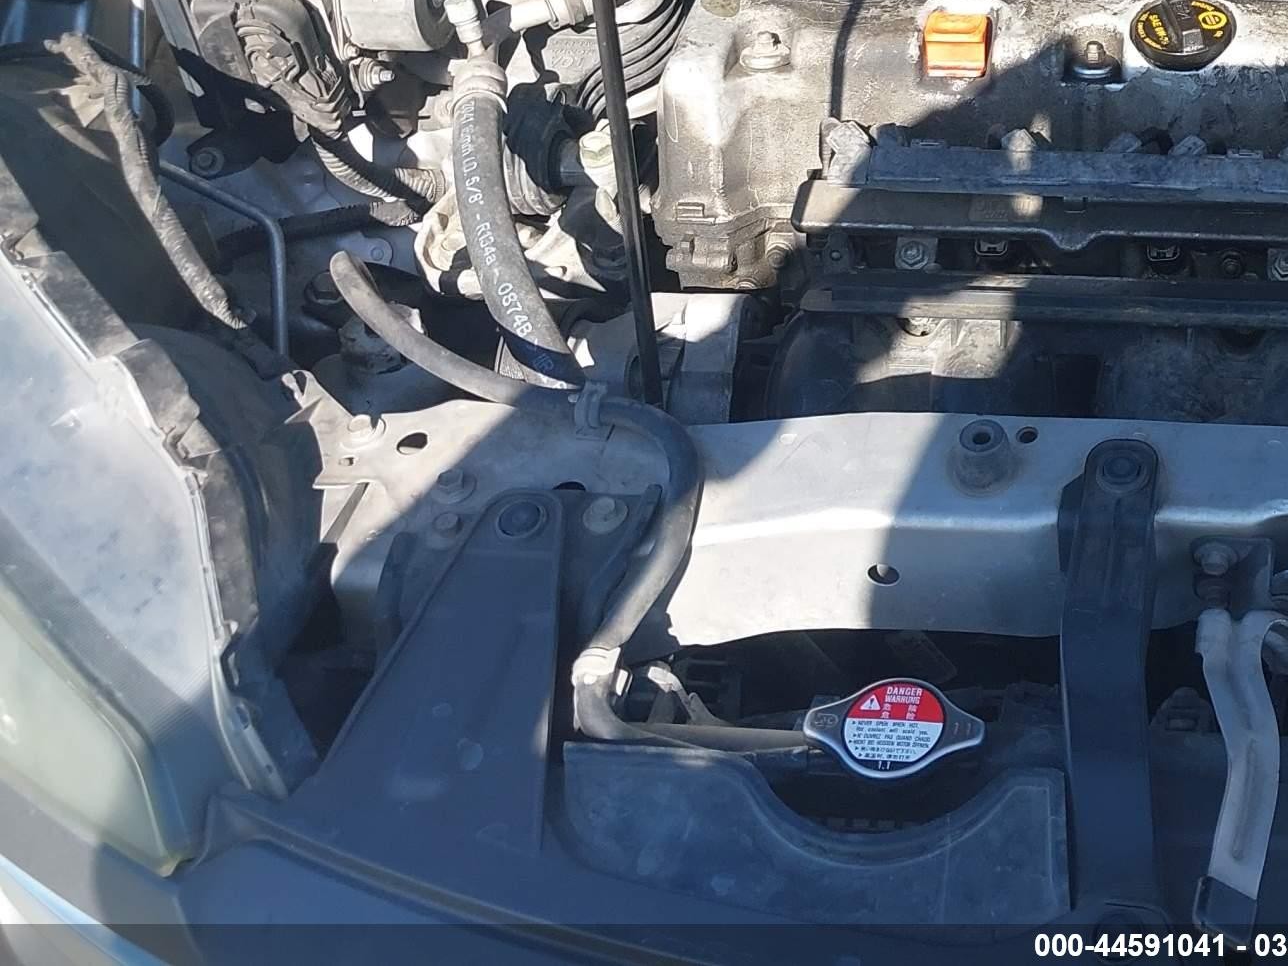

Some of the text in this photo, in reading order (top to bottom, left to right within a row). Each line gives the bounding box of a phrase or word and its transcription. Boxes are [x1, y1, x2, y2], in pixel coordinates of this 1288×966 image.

[1149, 14, 1162, 28] SAE
[476, 222, 497, 266] R134a
[498, 282, 533, 338] 0874B
[886, 686, 923, 697] DANGER
[878, 761, 891, 770] 1.1
